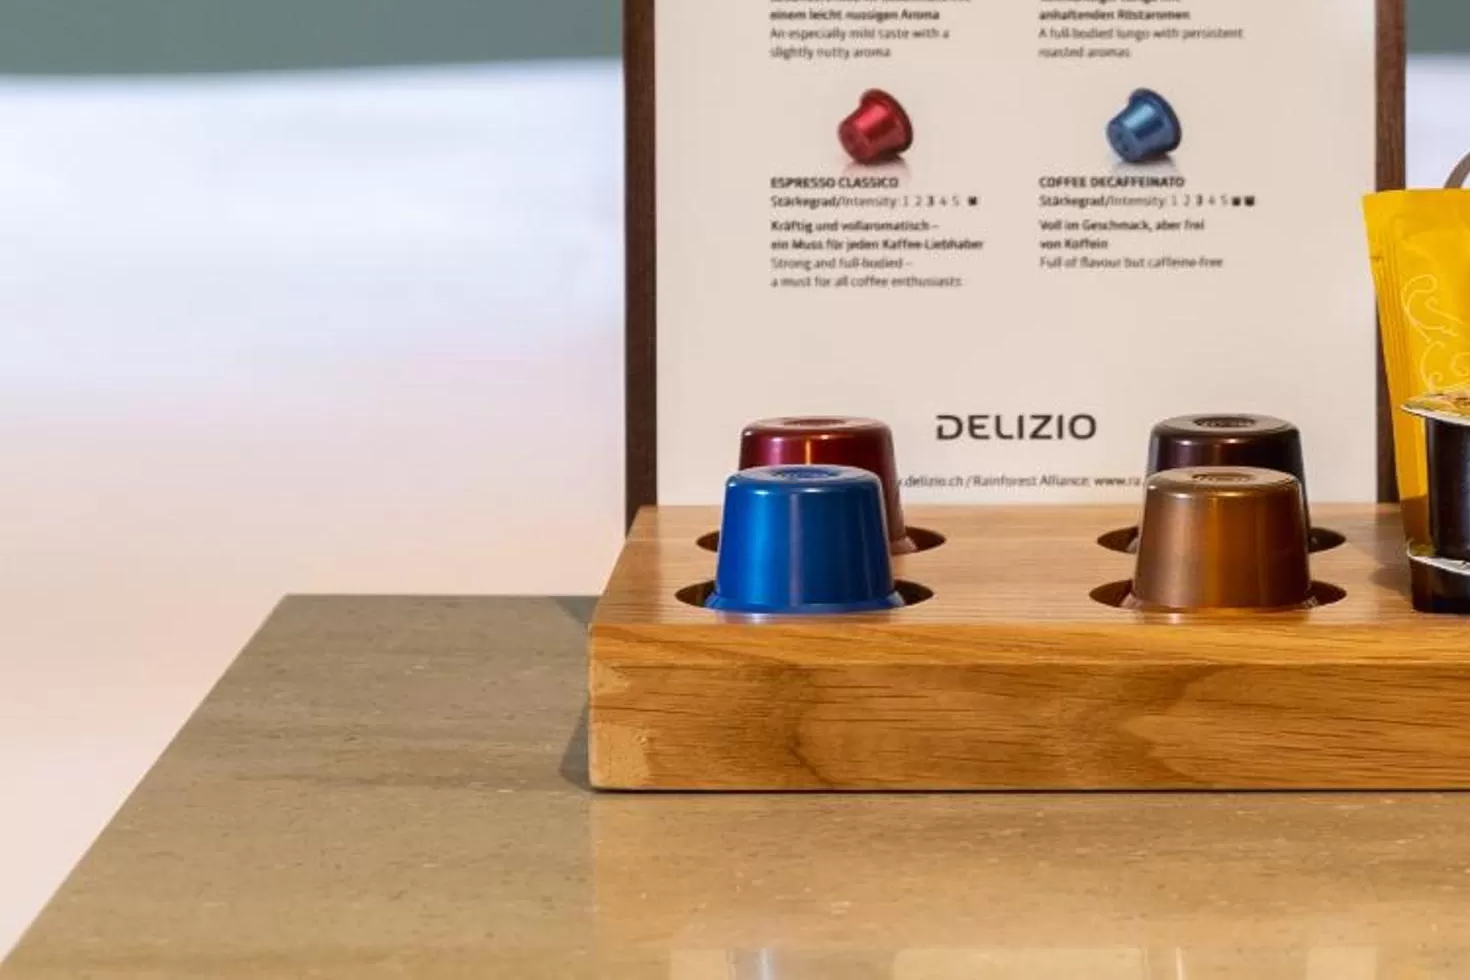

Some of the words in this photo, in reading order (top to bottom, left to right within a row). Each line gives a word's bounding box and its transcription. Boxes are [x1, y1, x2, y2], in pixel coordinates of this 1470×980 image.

[770, 11, 806, 20] einem
[809, 9, 842, 20] leicht
[846, 10, 898, 23] nussigen
[901, 9, 939, 20] Aroma
[1039, 9, 1114, 21] anhaltenden
[770, 29, 785, 38] An
[788, 28, 846, 40] especially
[850, 28, 875, 38] mild
[878, 29, 909, 38] taste
[912, 28, 939, 38] with
[1038, 29, 1047, 38] A
[1117, 28, 1149, 41] lungo
[1153, 28, 1179, 39] with
[1182, 29, 1243, 40] persistent
[770, 47, 813, 60] slightly
[817, 47, 849, 60] nutty
[853, 49, 890, 57] aroma
[1038, 47, 1084, 58] roasted
[1088, 49, 1129, 57] aromas
[771, 177, 835, 189] ESPRESSO
[838, 177, 899, 189] CLASSICO
[1039, 177, 1087, 188] COFFEE
[1090, 177, 1185, 188] DECAFFEINATO
[927, 196, 934, 206] 3
[939, 196, 947, 206] 4
[1196, 196, 1203, 206] 3
[771, 221, 813, 233] Kräftig
[816, 221, 838, 231] und
[841, 221, 929, 231] vollaromatisch
[1039, 221, 1062, 230] Voll
[1065, 221, 1079, 230] im
[1082, 221, 1152, 232] Geschmack,
[1156, 221, 1181, 230] aber
[1184, 221, 1204, 230] frei
[771, 239, 789, 249] ein
[792, 239, 823, 249] Muss
[826, 239, 843, 249] für
[846, 239, 879, 252] jeden
[1040, 241, 1061, 249] von
[1064, 239, 1108, 249] Koffein
[771, 258, 811, 270] Strong
[814, 258, 836, 268] and
[1040, 257, 1061, 267] Full
[1065, 257, 1077, 267] of
[1080, 257, 1121, 267] flavour
[1125, 257, 1144, 267] but
[771, 279, 778, 287] a
[781, 276, 811, 287] must
[814, 276, 831, 287] for
[835, 276, 848, 287] all
[850, 276, 888, 287] coffee
[891, 276, 961, 287] enthusiasts
[936, 414, 1097, 440] DELIZIO
[974, 476, 1036, 487] Rainforest
